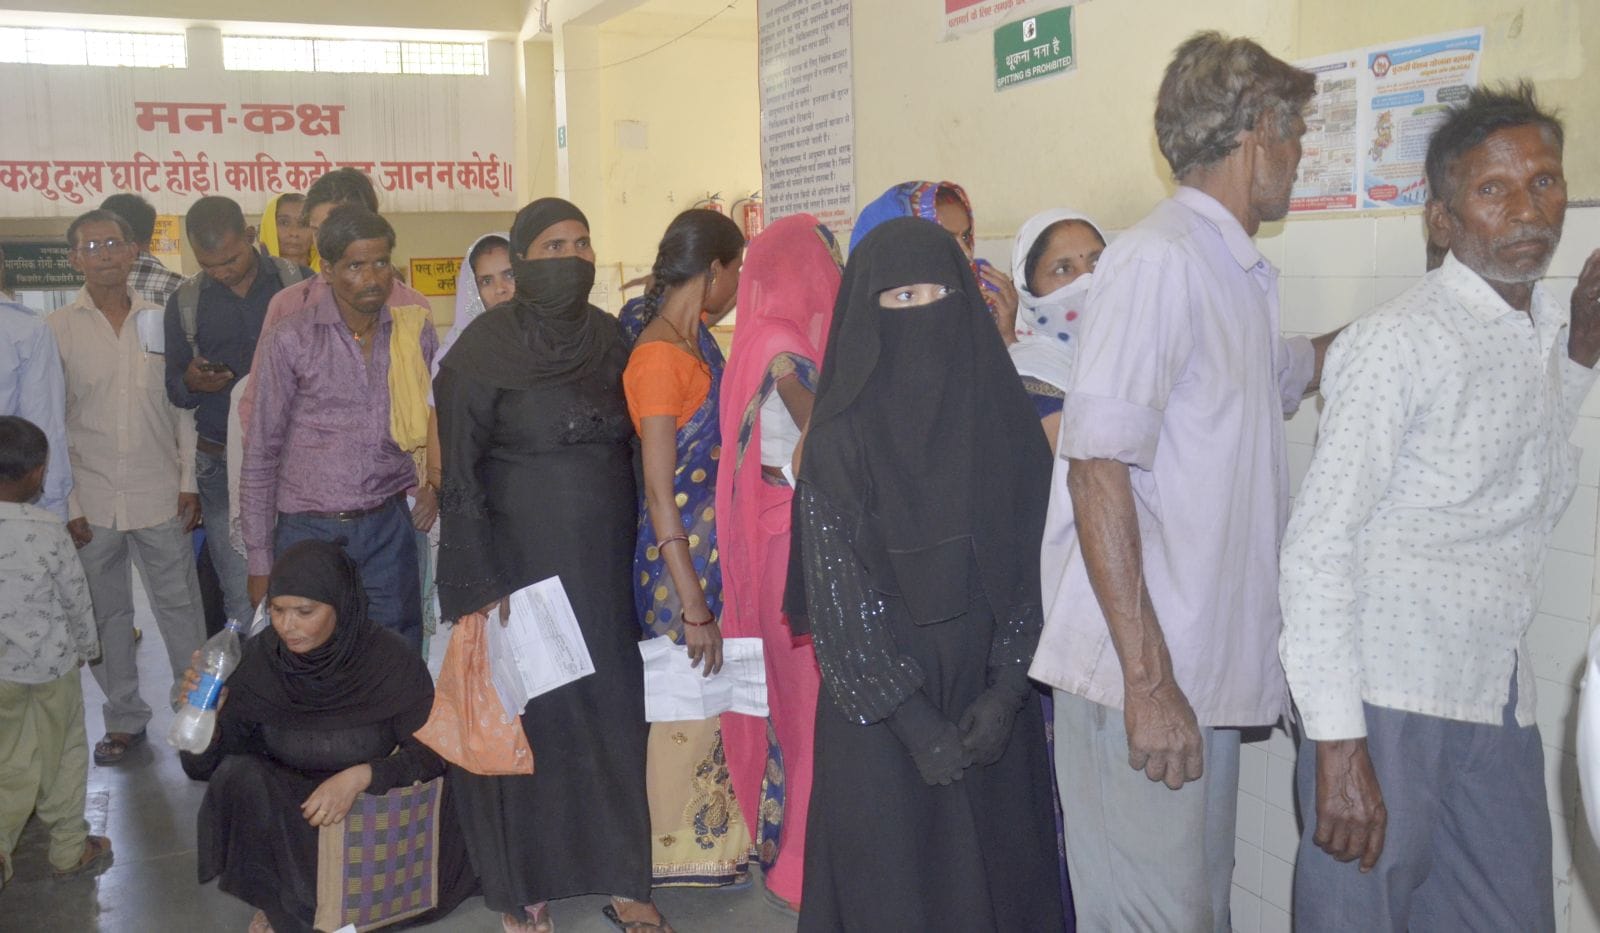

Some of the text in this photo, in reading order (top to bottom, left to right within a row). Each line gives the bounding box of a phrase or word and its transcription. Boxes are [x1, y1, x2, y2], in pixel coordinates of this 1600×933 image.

[1006, 36, 1060, 70] थूकना मना है
[998, 55, 1071, 86] SPITTING IS PROHIBITED
[134, 101, 345, 136] मन-कक्ष
[0, 160, 59, 200] कछु
[106, 151, 160, 192] घटि
[225, 152, 284, 194] काहि
